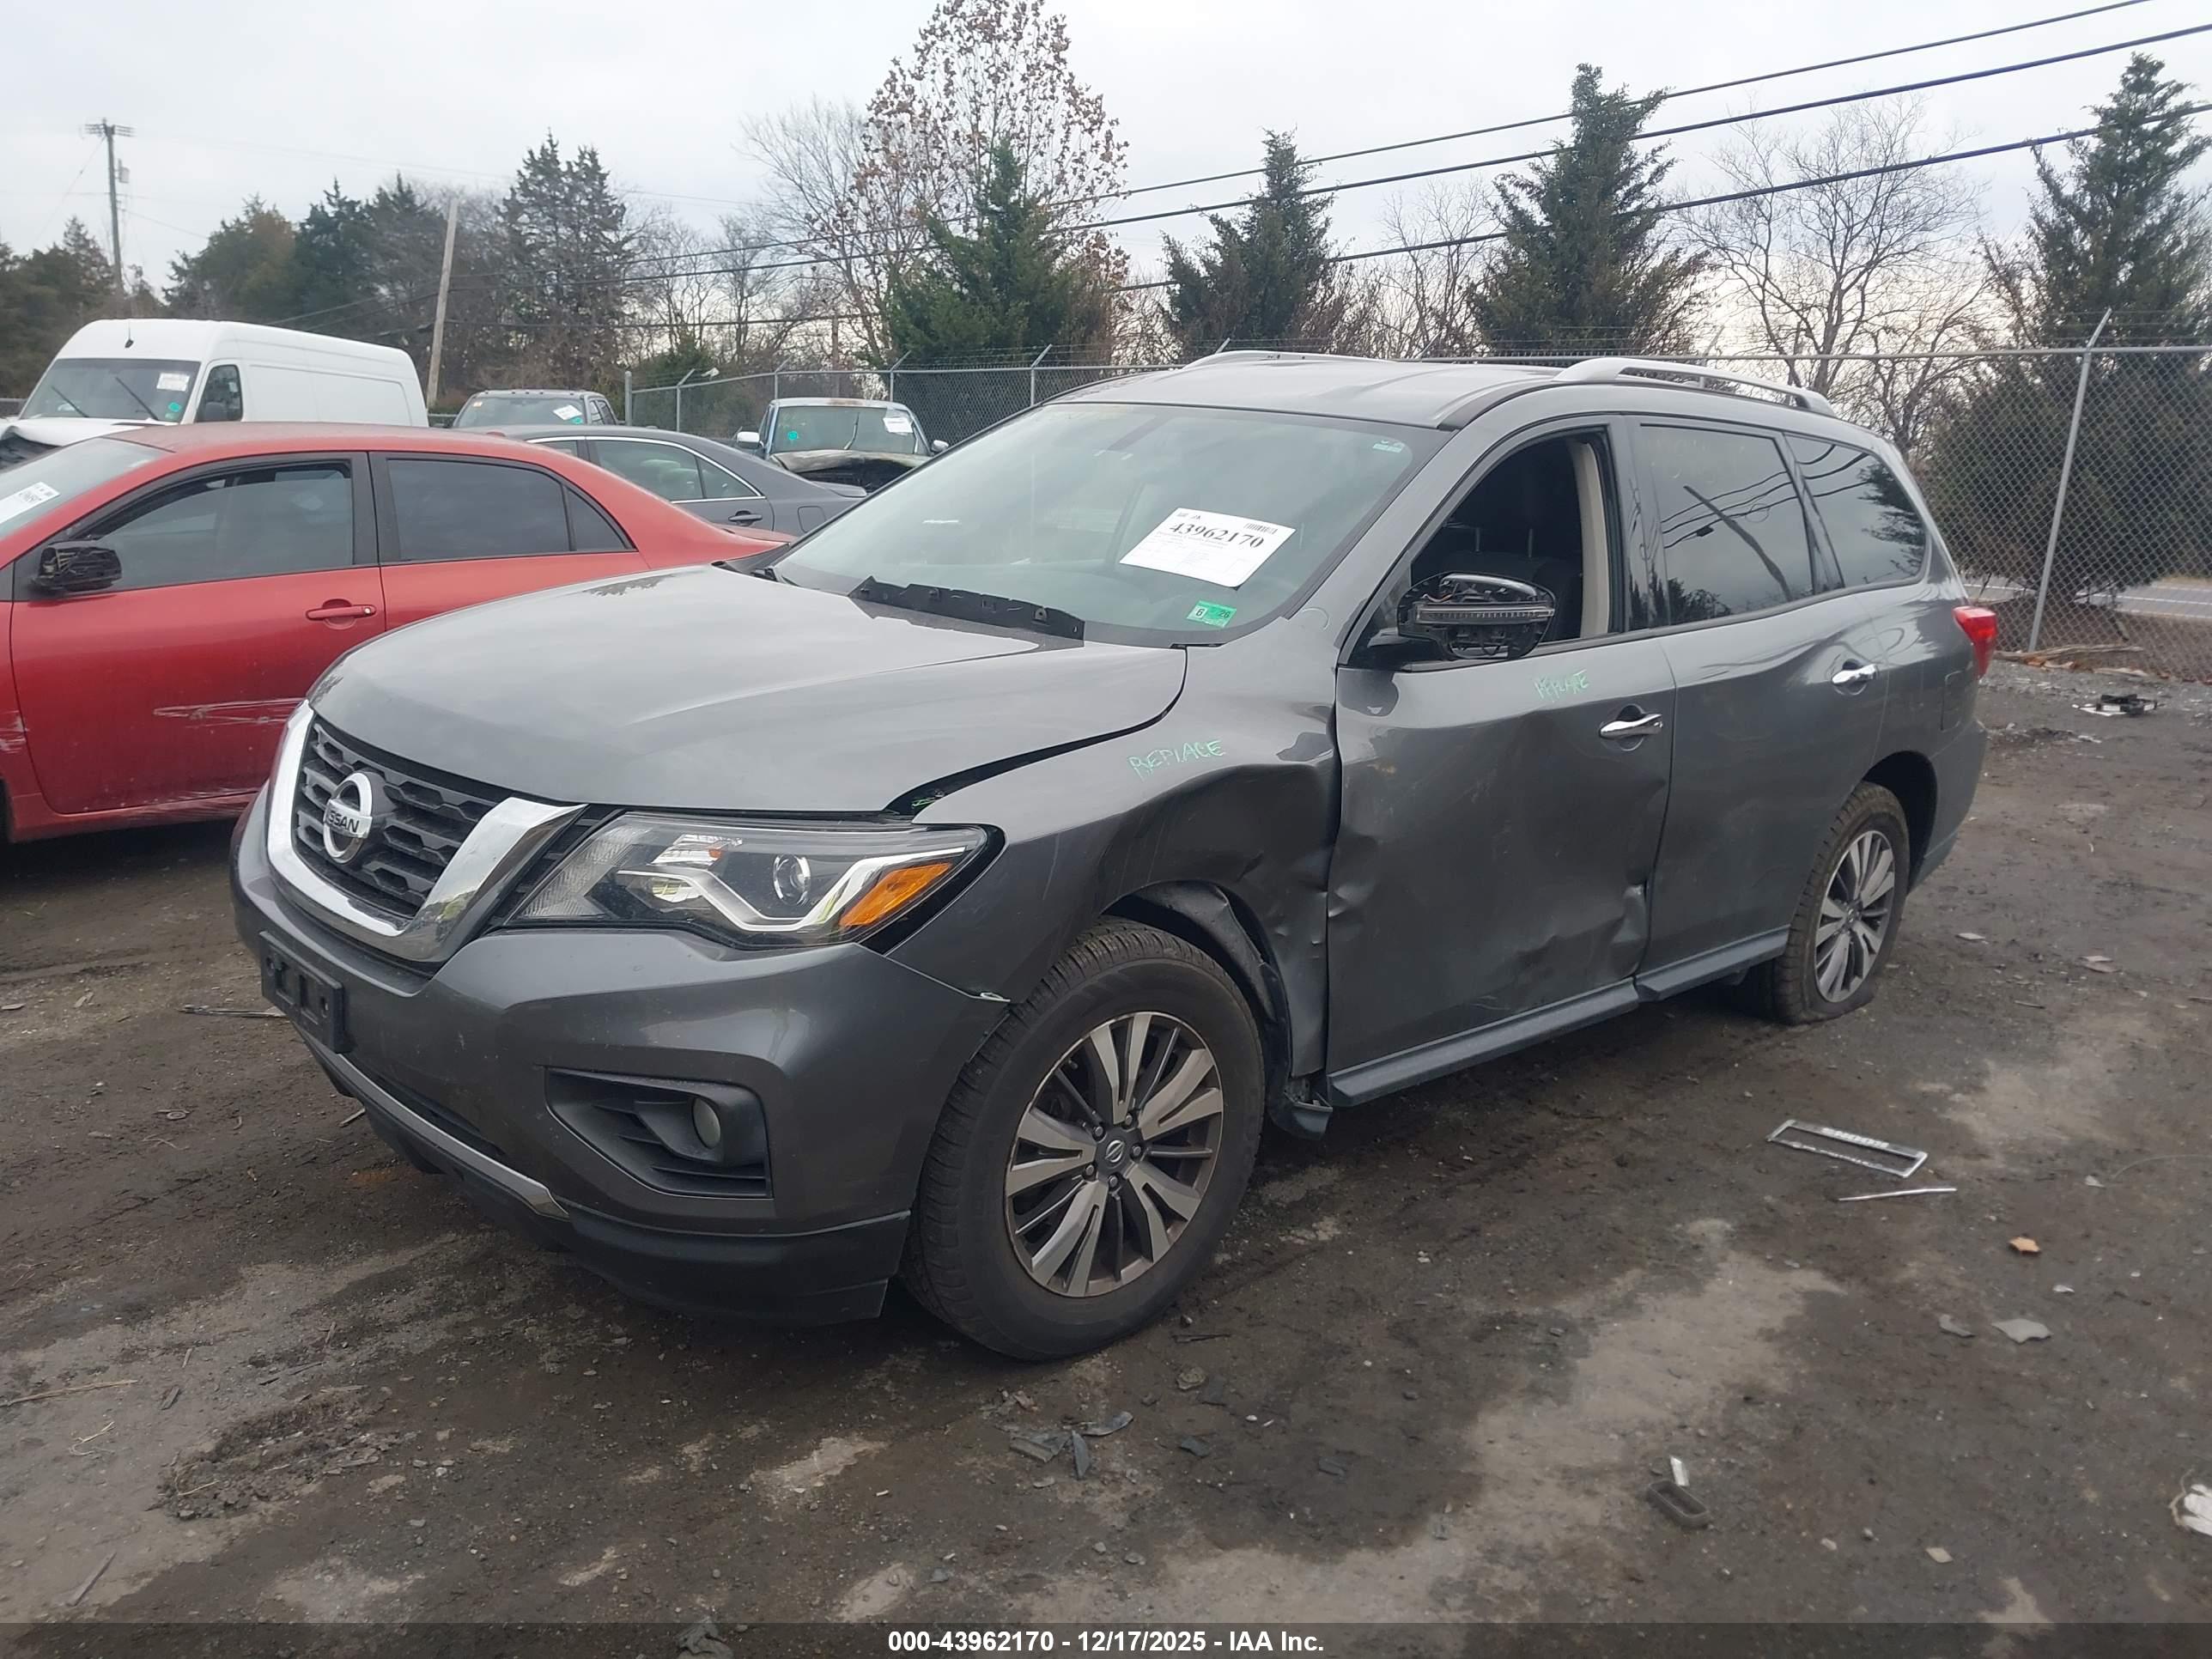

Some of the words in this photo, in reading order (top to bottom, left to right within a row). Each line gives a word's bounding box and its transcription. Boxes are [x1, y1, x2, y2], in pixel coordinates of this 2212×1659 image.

[1170, 522, 1265, 549] 43962170
[1195, 608, 1206, 617] 6
[1218, 610, 1231, 619] 26
[1128, 738, 1226, 782] REPLACE
